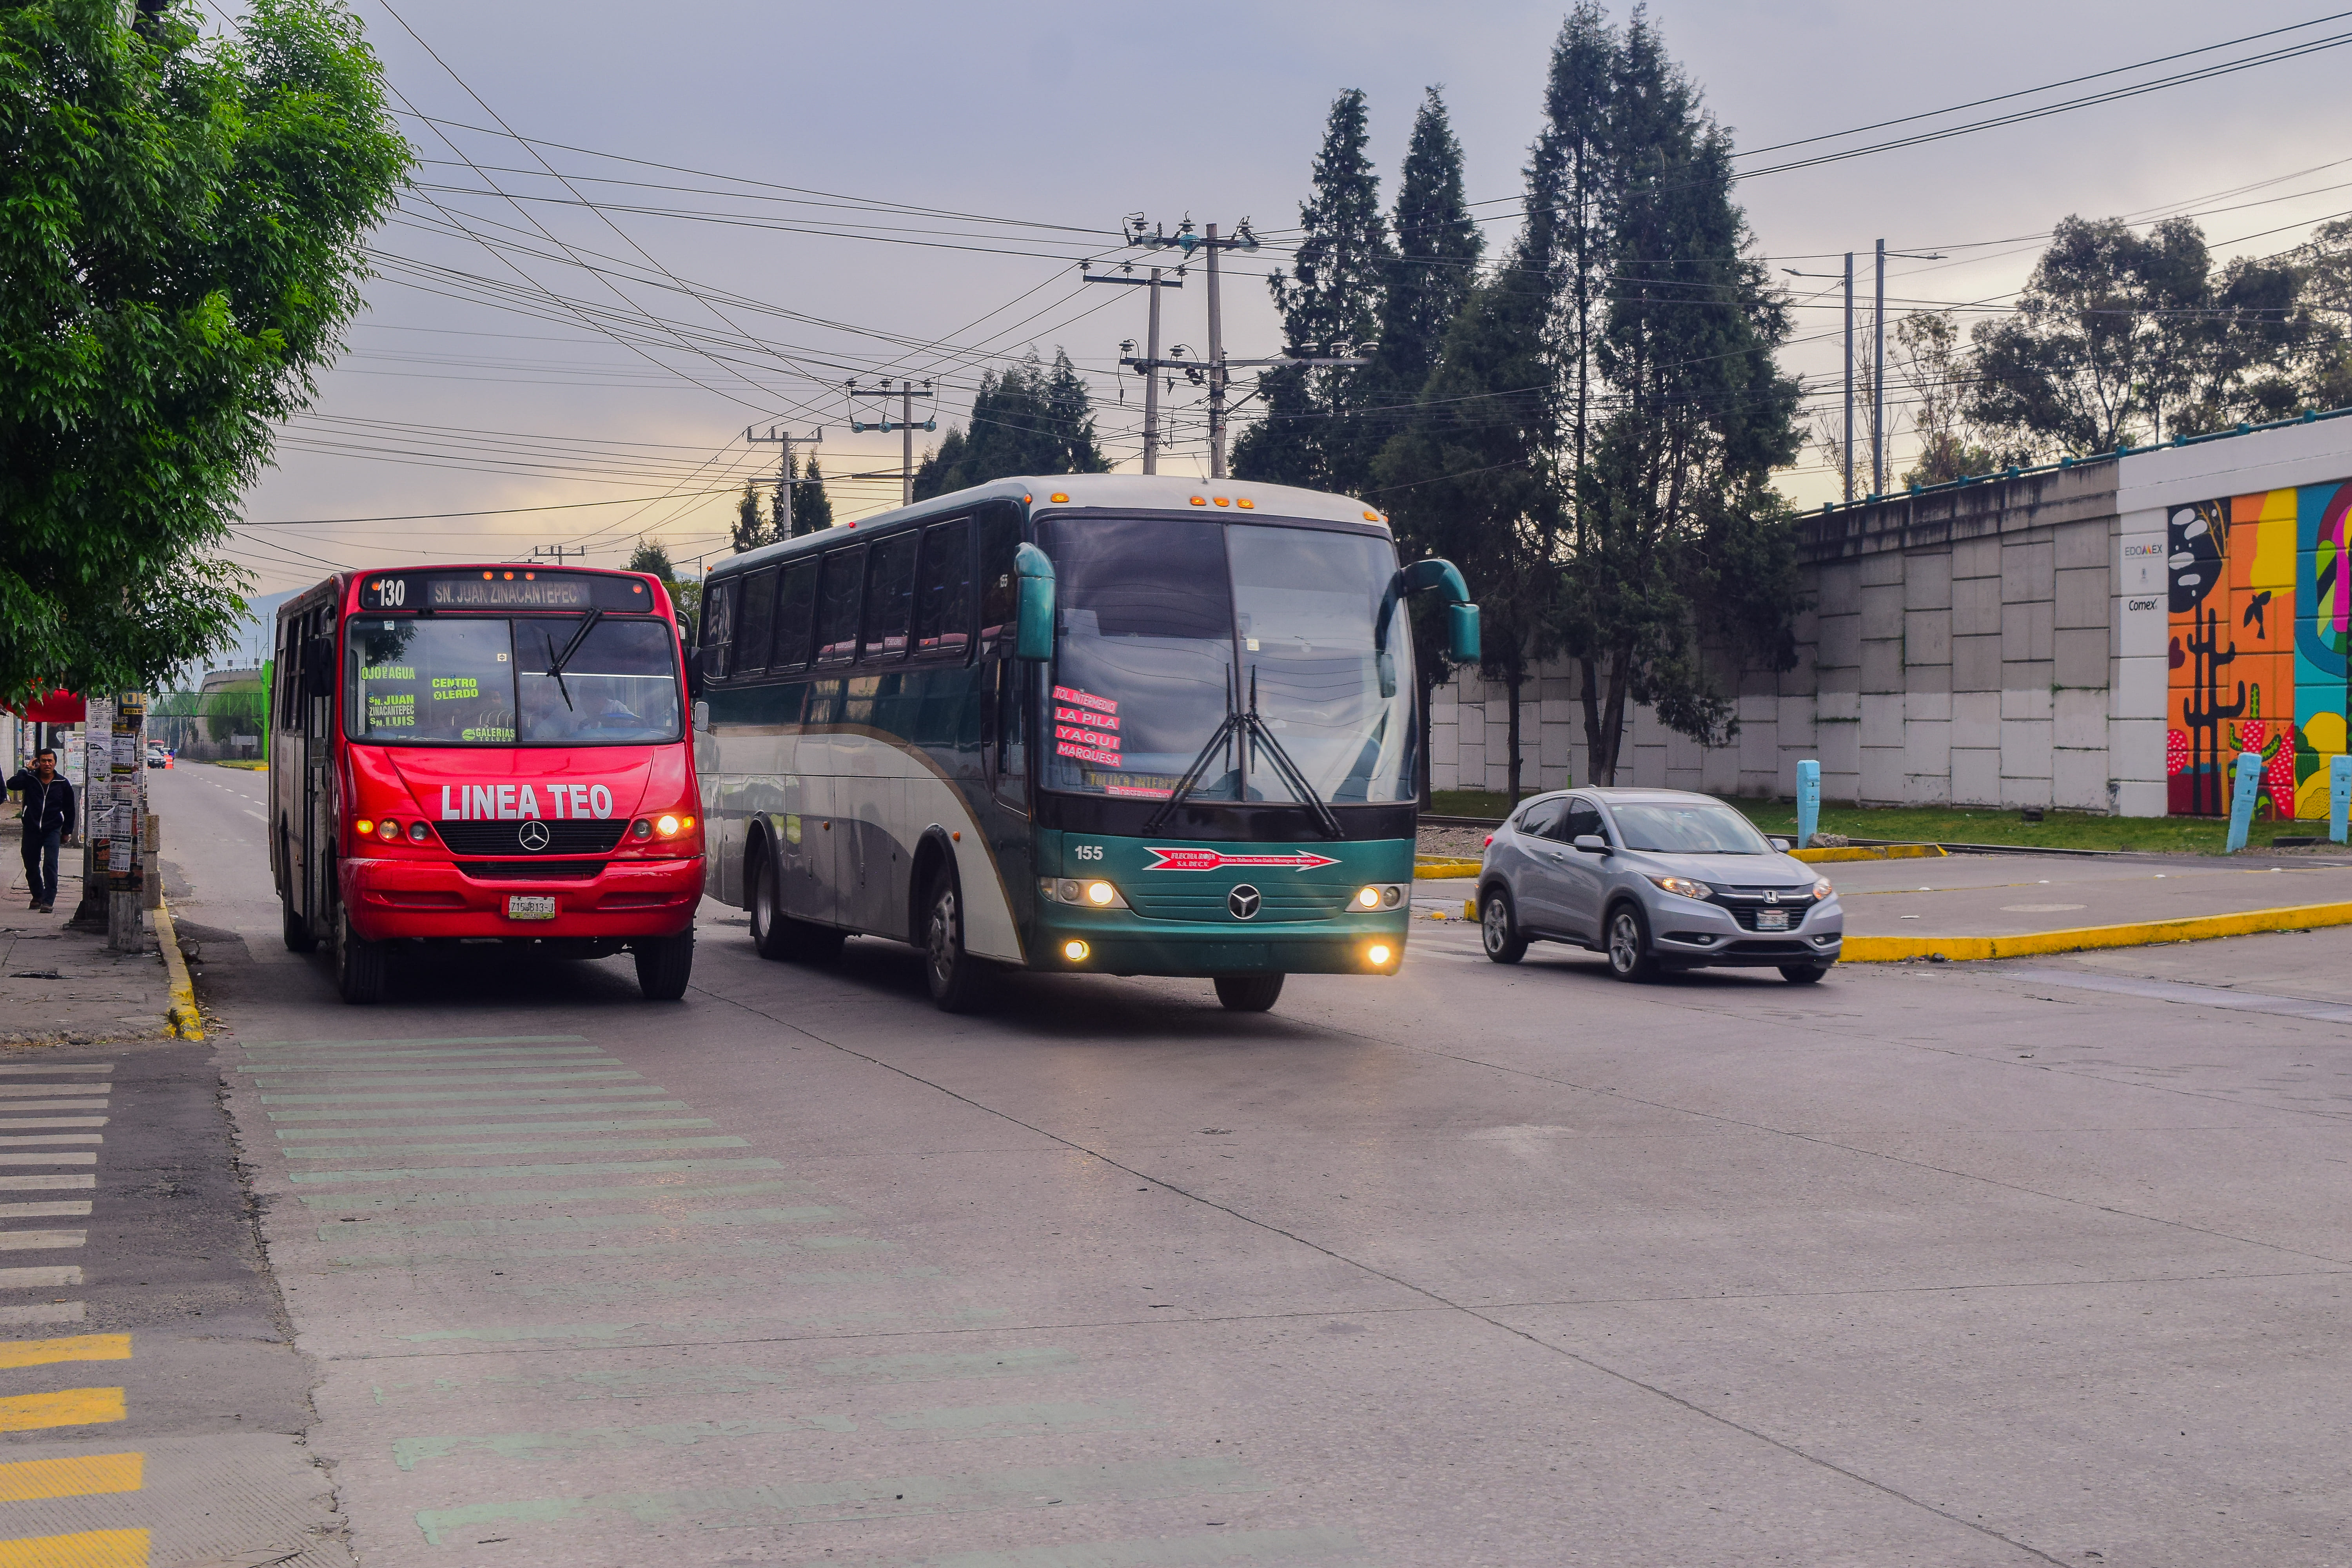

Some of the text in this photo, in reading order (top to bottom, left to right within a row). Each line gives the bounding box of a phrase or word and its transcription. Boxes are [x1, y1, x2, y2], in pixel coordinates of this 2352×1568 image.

[378, 579, 405, 606] 130
[435, 582, 577, 603] SN. JUAN ZINACANTEPEC
[2129, 598, 2158, 611] Comex
[362, 666, 381, 679] OJO
[389, 667, 415, 679] AGUA
[432, 678, 477, 688] CENTRO
[369, 695, 414, 705] SN. JUAN
[443, 688, 478, 699] LERDO
[1056, 688, 1116, 712] TOL INTERMEDIO
[369, 705, 414, 716] ZINACANTEPEC
[370, 716, 415, 727] SN. LUIS
[1056, 709, 1116, 729] LA PILA
[1060, 728, 1118, 748] YAQUI
[1058, 744, 1120, 766] MARQUESA
[442, 784, 613, 820] LINEA TEO
[1075, 845, 1103, 860] 155
